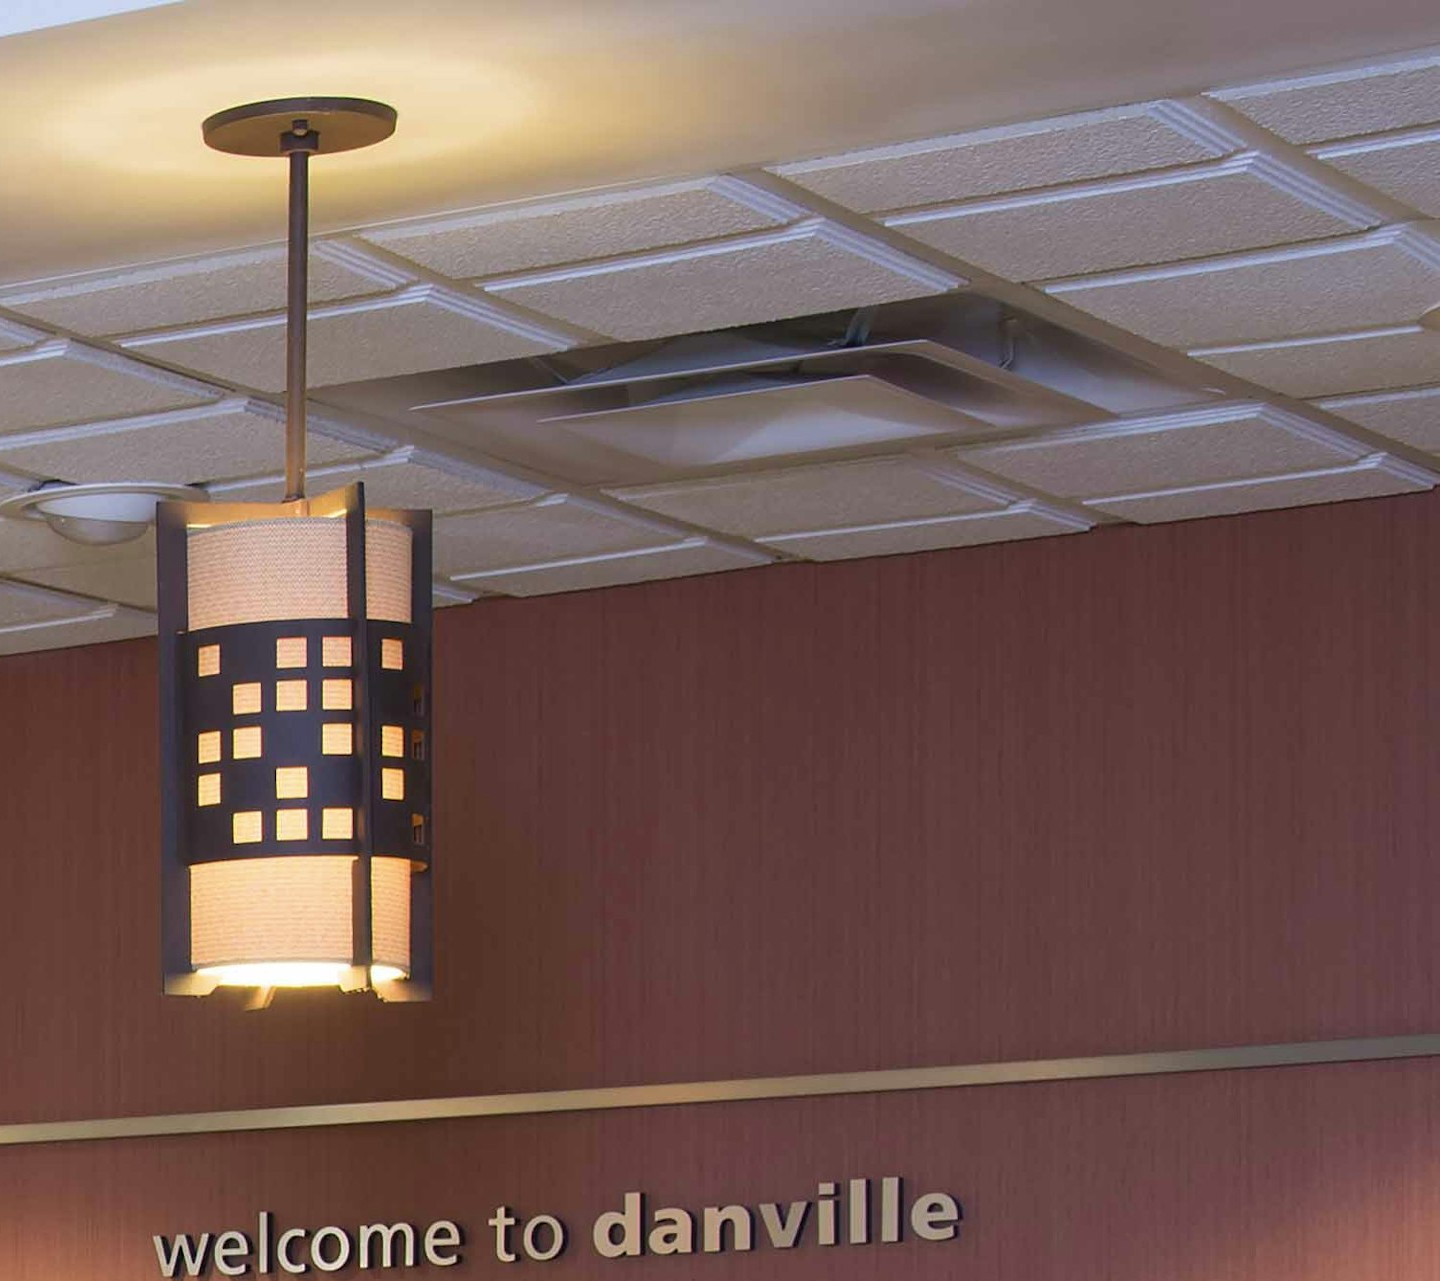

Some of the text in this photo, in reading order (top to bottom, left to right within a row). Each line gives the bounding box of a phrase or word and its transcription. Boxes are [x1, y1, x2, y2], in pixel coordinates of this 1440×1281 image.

[153, 1176, 961, 1278] welcome to danville
